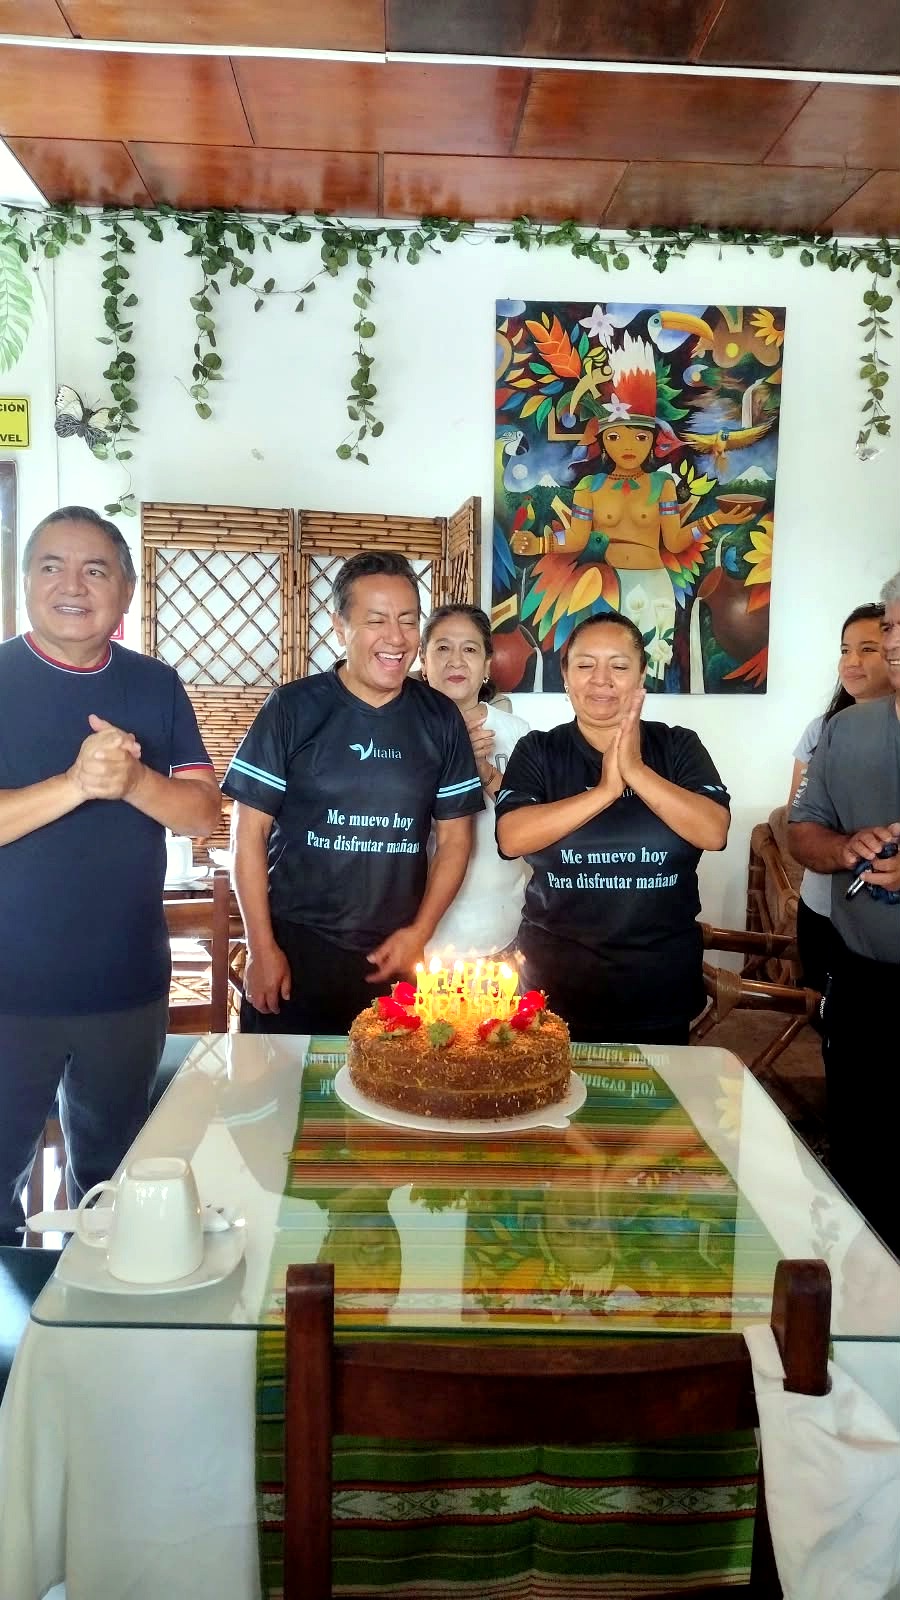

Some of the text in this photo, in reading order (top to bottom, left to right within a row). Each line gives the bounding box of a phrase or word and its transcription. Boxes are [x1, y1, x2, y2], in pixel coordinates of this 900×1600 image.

[349, 737, 402, 760] Vitalia
[326, 809, 414, 832] Me muevo hoy
[307, 830, 420, 854] Para disfrutar mañan
[560, 846, 669, 866] Me muevo hoy
[546, 871, 573, 889] Para
[576, 872, 633, 889] disfrutar
